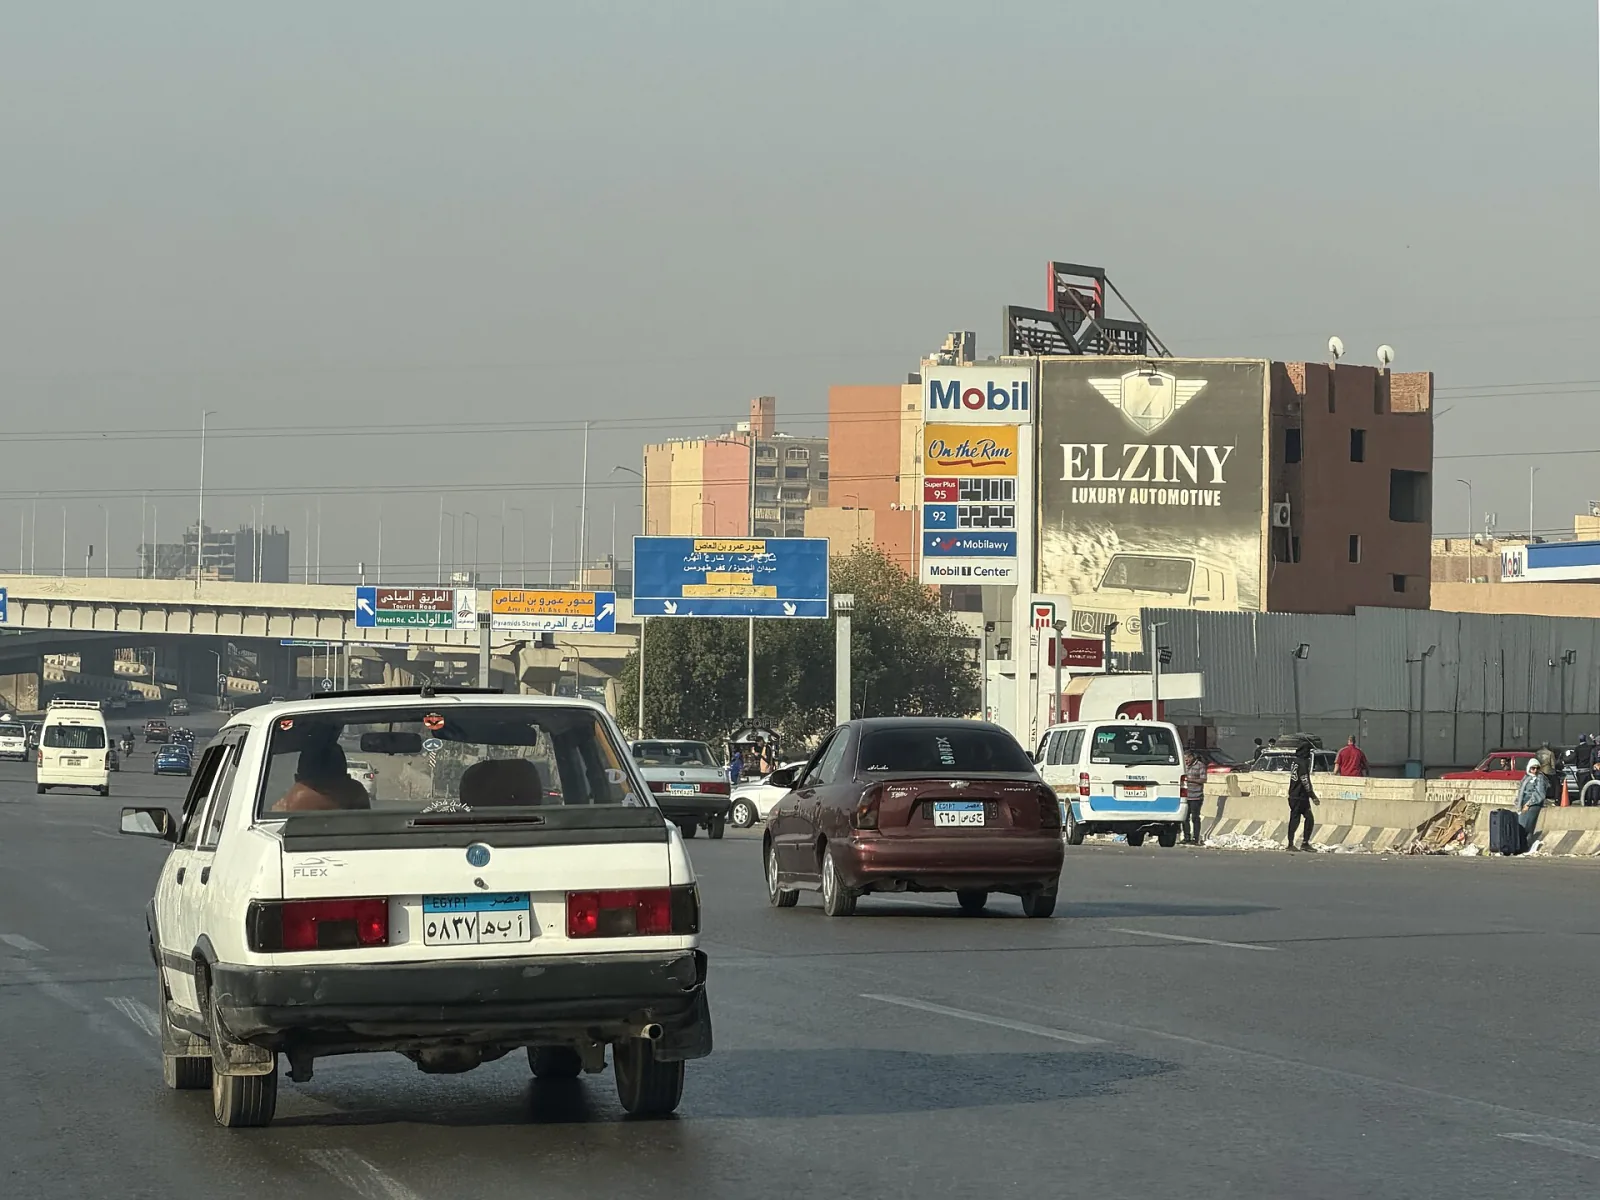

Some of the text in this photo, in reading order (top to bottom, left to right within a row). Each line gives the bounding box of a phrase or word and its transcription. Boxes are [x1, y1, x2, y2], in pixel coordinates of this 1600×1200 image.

[930, 380, 1028, 410] Mobil
[928, 439, 1012, 460] On the Run
[1060, 444, 1234, 484] ELZINY
[934, 490, 946, 499] 95
[1072, 488, 1221, 506] LUXURY AUTOMOTIVE
[932, 512, 946, 521] 92
[694, 542, 717, 551] العاص
[718, 543, 727, 551] بن
[963, 540, 1008, 551] Mobilawy
[684, 553, 702, 561] الهرم
[704, 553, 724, 562] شارع
[734, 564, 755, 572] الجيزة
[1501, 552, 1522, 575] Mobil
[930, 566, 1010, 576] Mobil 1 Center
[419, 591, 448, 604] الطريق
[496, 592, 524, 604] العاص
[527, 598, 536, 606] بن
[567, 597, 594, 606] محور
[544, 617, 594, 630] شارع الهرم
[293, 868, 328, 878] FLEX
[432, 896, 468, 908] EGYPT
[490, 896, 520, 906] مصر
[427, 917, 476, 940] ٥٨٣٧
